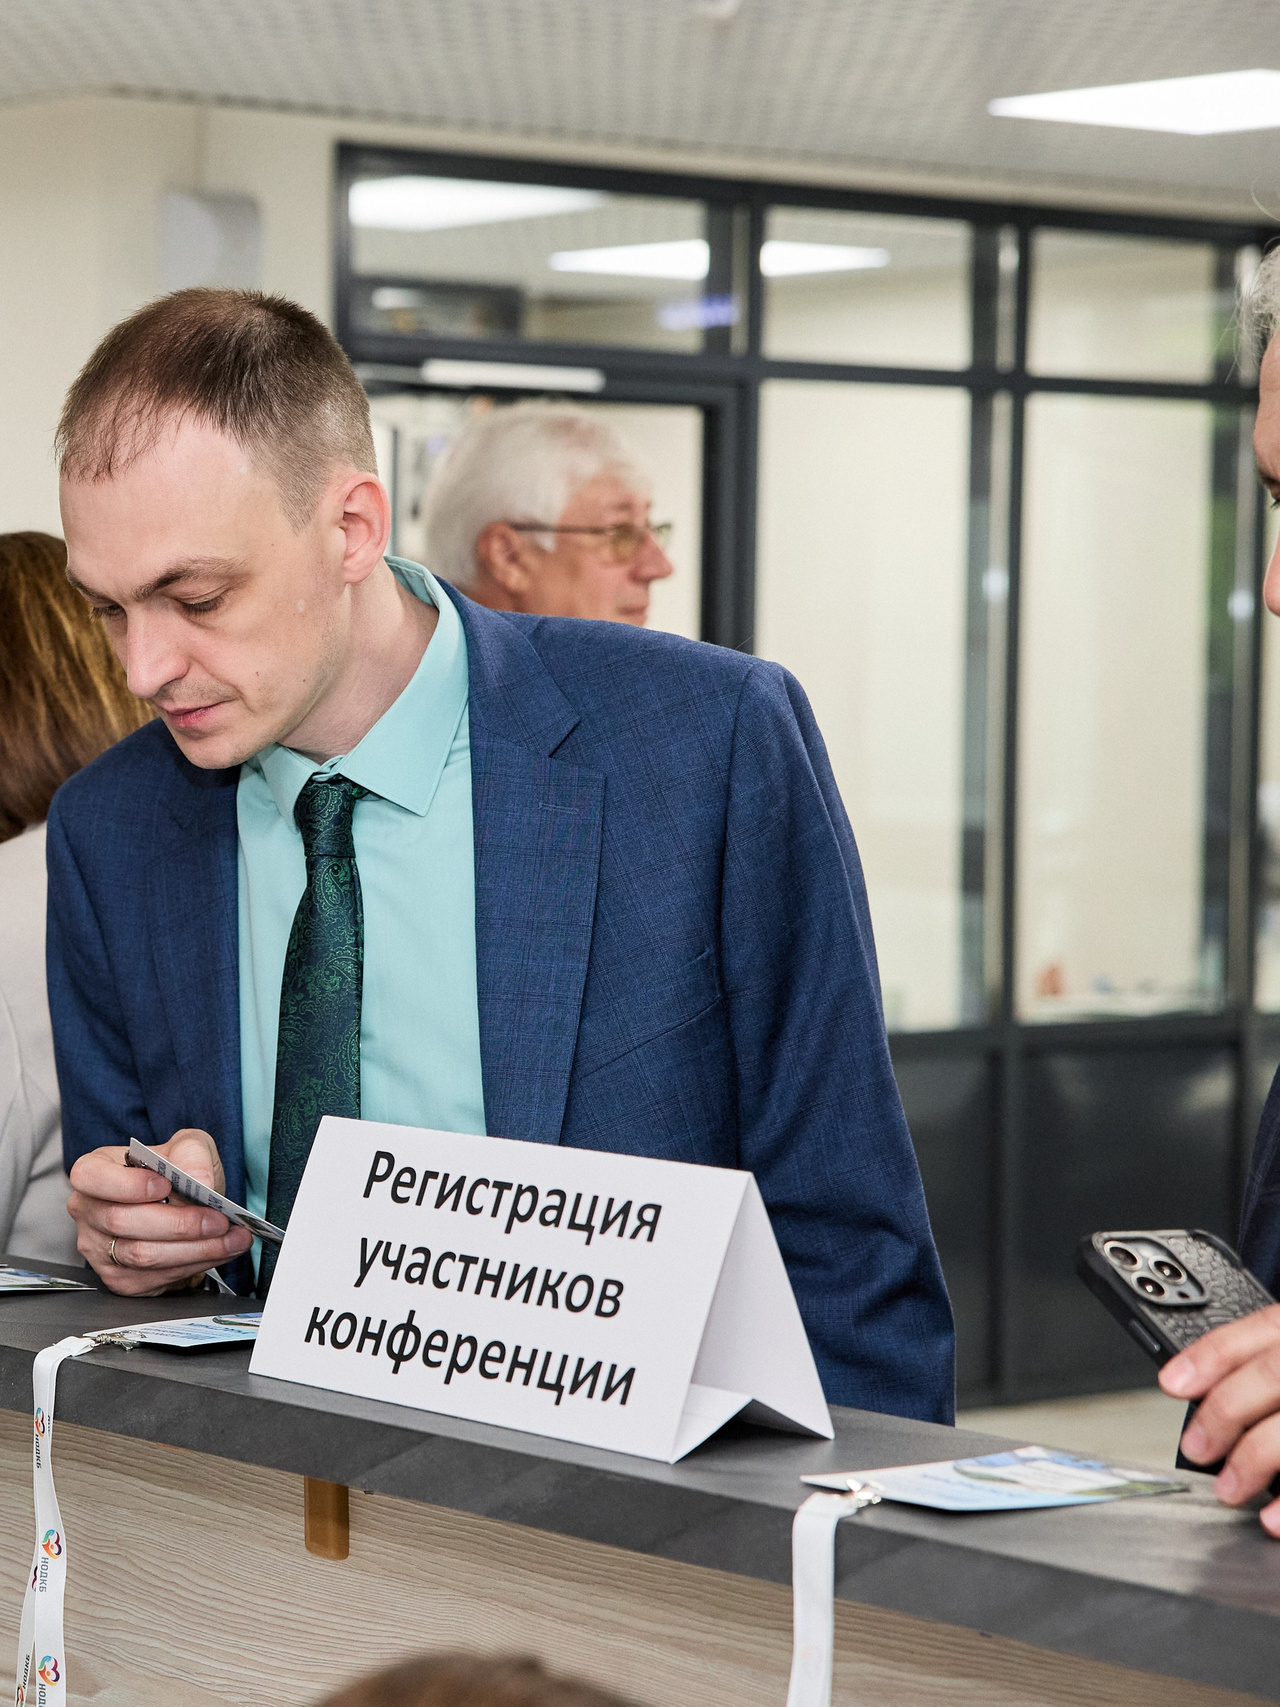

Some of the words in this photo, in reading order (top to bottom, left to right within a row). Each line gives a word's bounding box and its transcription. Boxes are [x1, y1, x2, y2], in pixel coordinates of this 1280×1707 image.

[363, 1150, 662, 1245] Регистрация
[354, 1237, 624, 1318] участников
[304, 1306, 637, 1406] конференции
[34, 1434, 42, 1469] НОДКБ
[38, 1557, 49, 1592] НОДКБ
[38, 1683, 46, 1707] НОД
